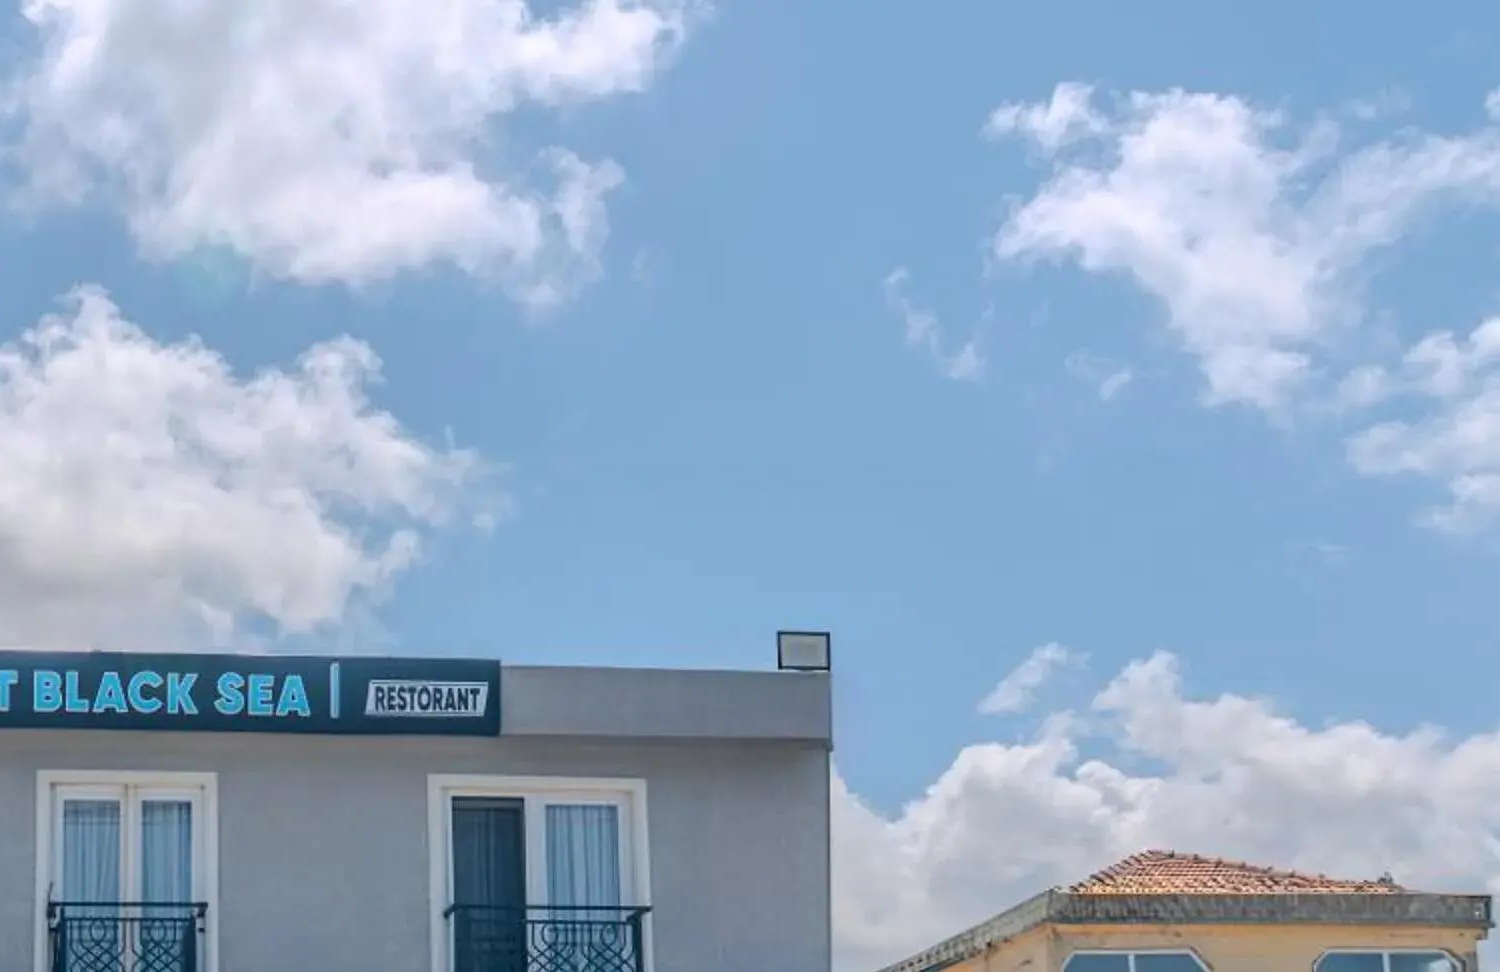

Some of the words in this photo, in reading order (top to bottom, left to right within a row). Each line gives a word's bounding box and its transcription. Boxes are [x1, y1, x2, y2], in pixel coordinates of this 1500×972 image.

[33, 670, 199, 714] BLACK
[214, 671, 311, 716] SEA
[374, 685, 481, 712] RESTORANT
